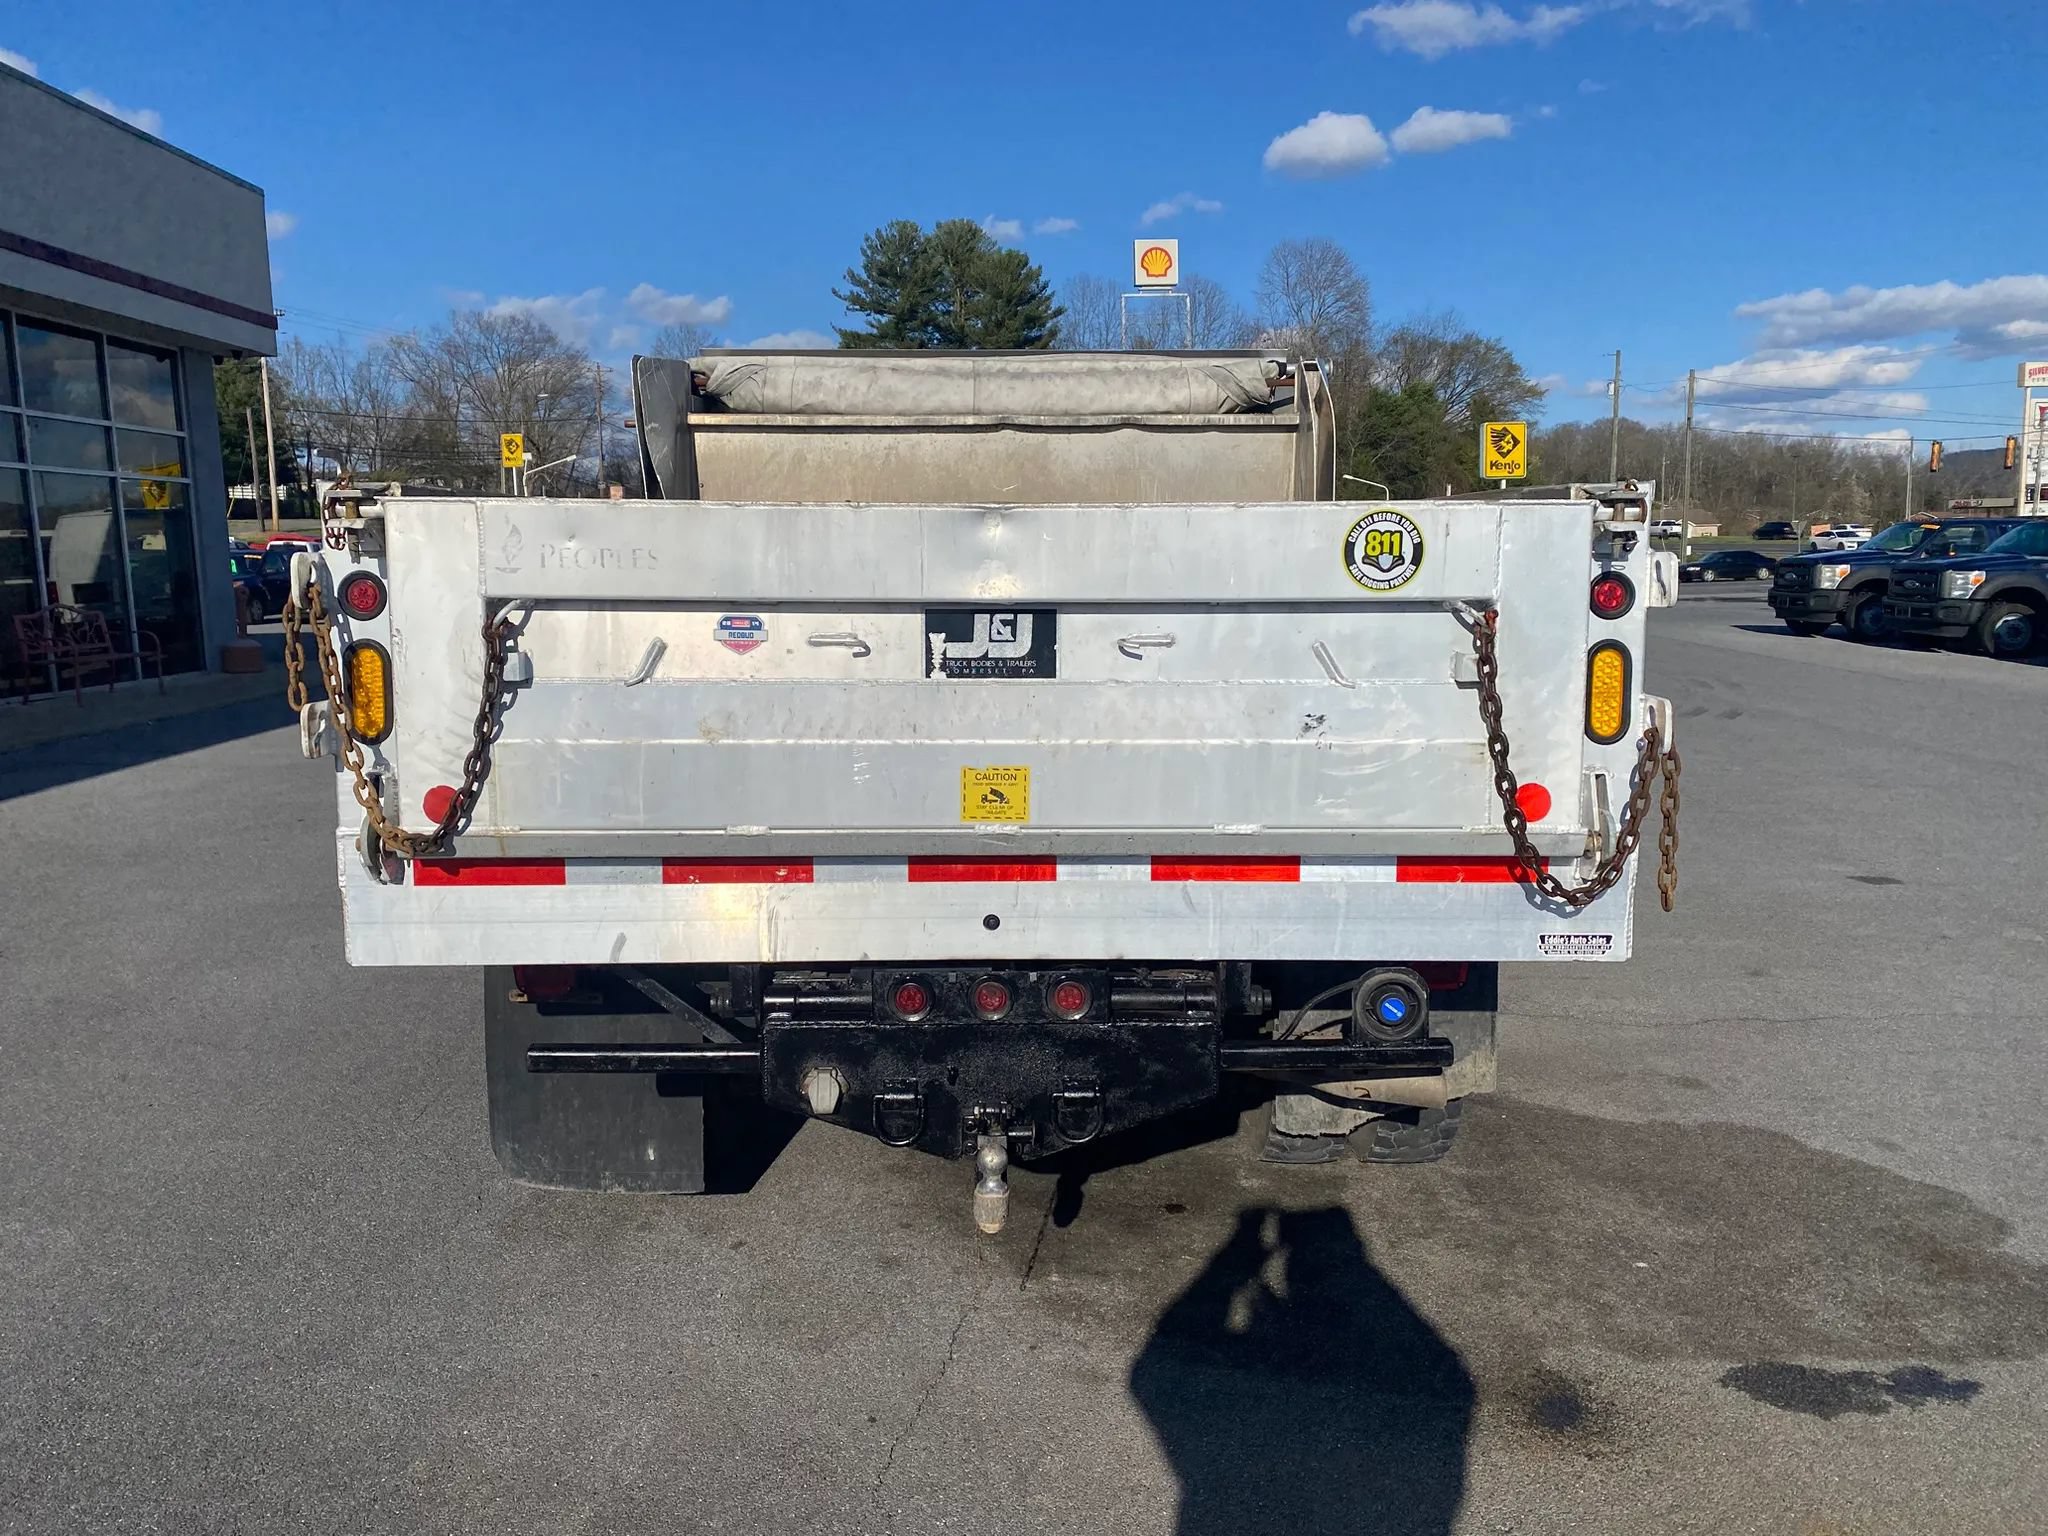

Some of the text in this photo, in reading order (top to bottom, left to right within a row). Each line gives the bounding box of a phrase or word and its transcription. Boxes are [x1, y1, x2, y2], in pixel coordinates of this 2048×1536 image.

[1348, 525, 1362, 543] CALL
[1372, 512, 1401, 523] BEFORE
[1400, 518, 1413, 531] YOU
[1411, 529, 1421, 544] DIG
[1366, 530, 1401, 556] 811
[540, 545, 659, 570] PEOPLES
[975, 773, 1017, 781] CAUTION
[1544, 935, 1607, 944] Eddie's Auto Sales
